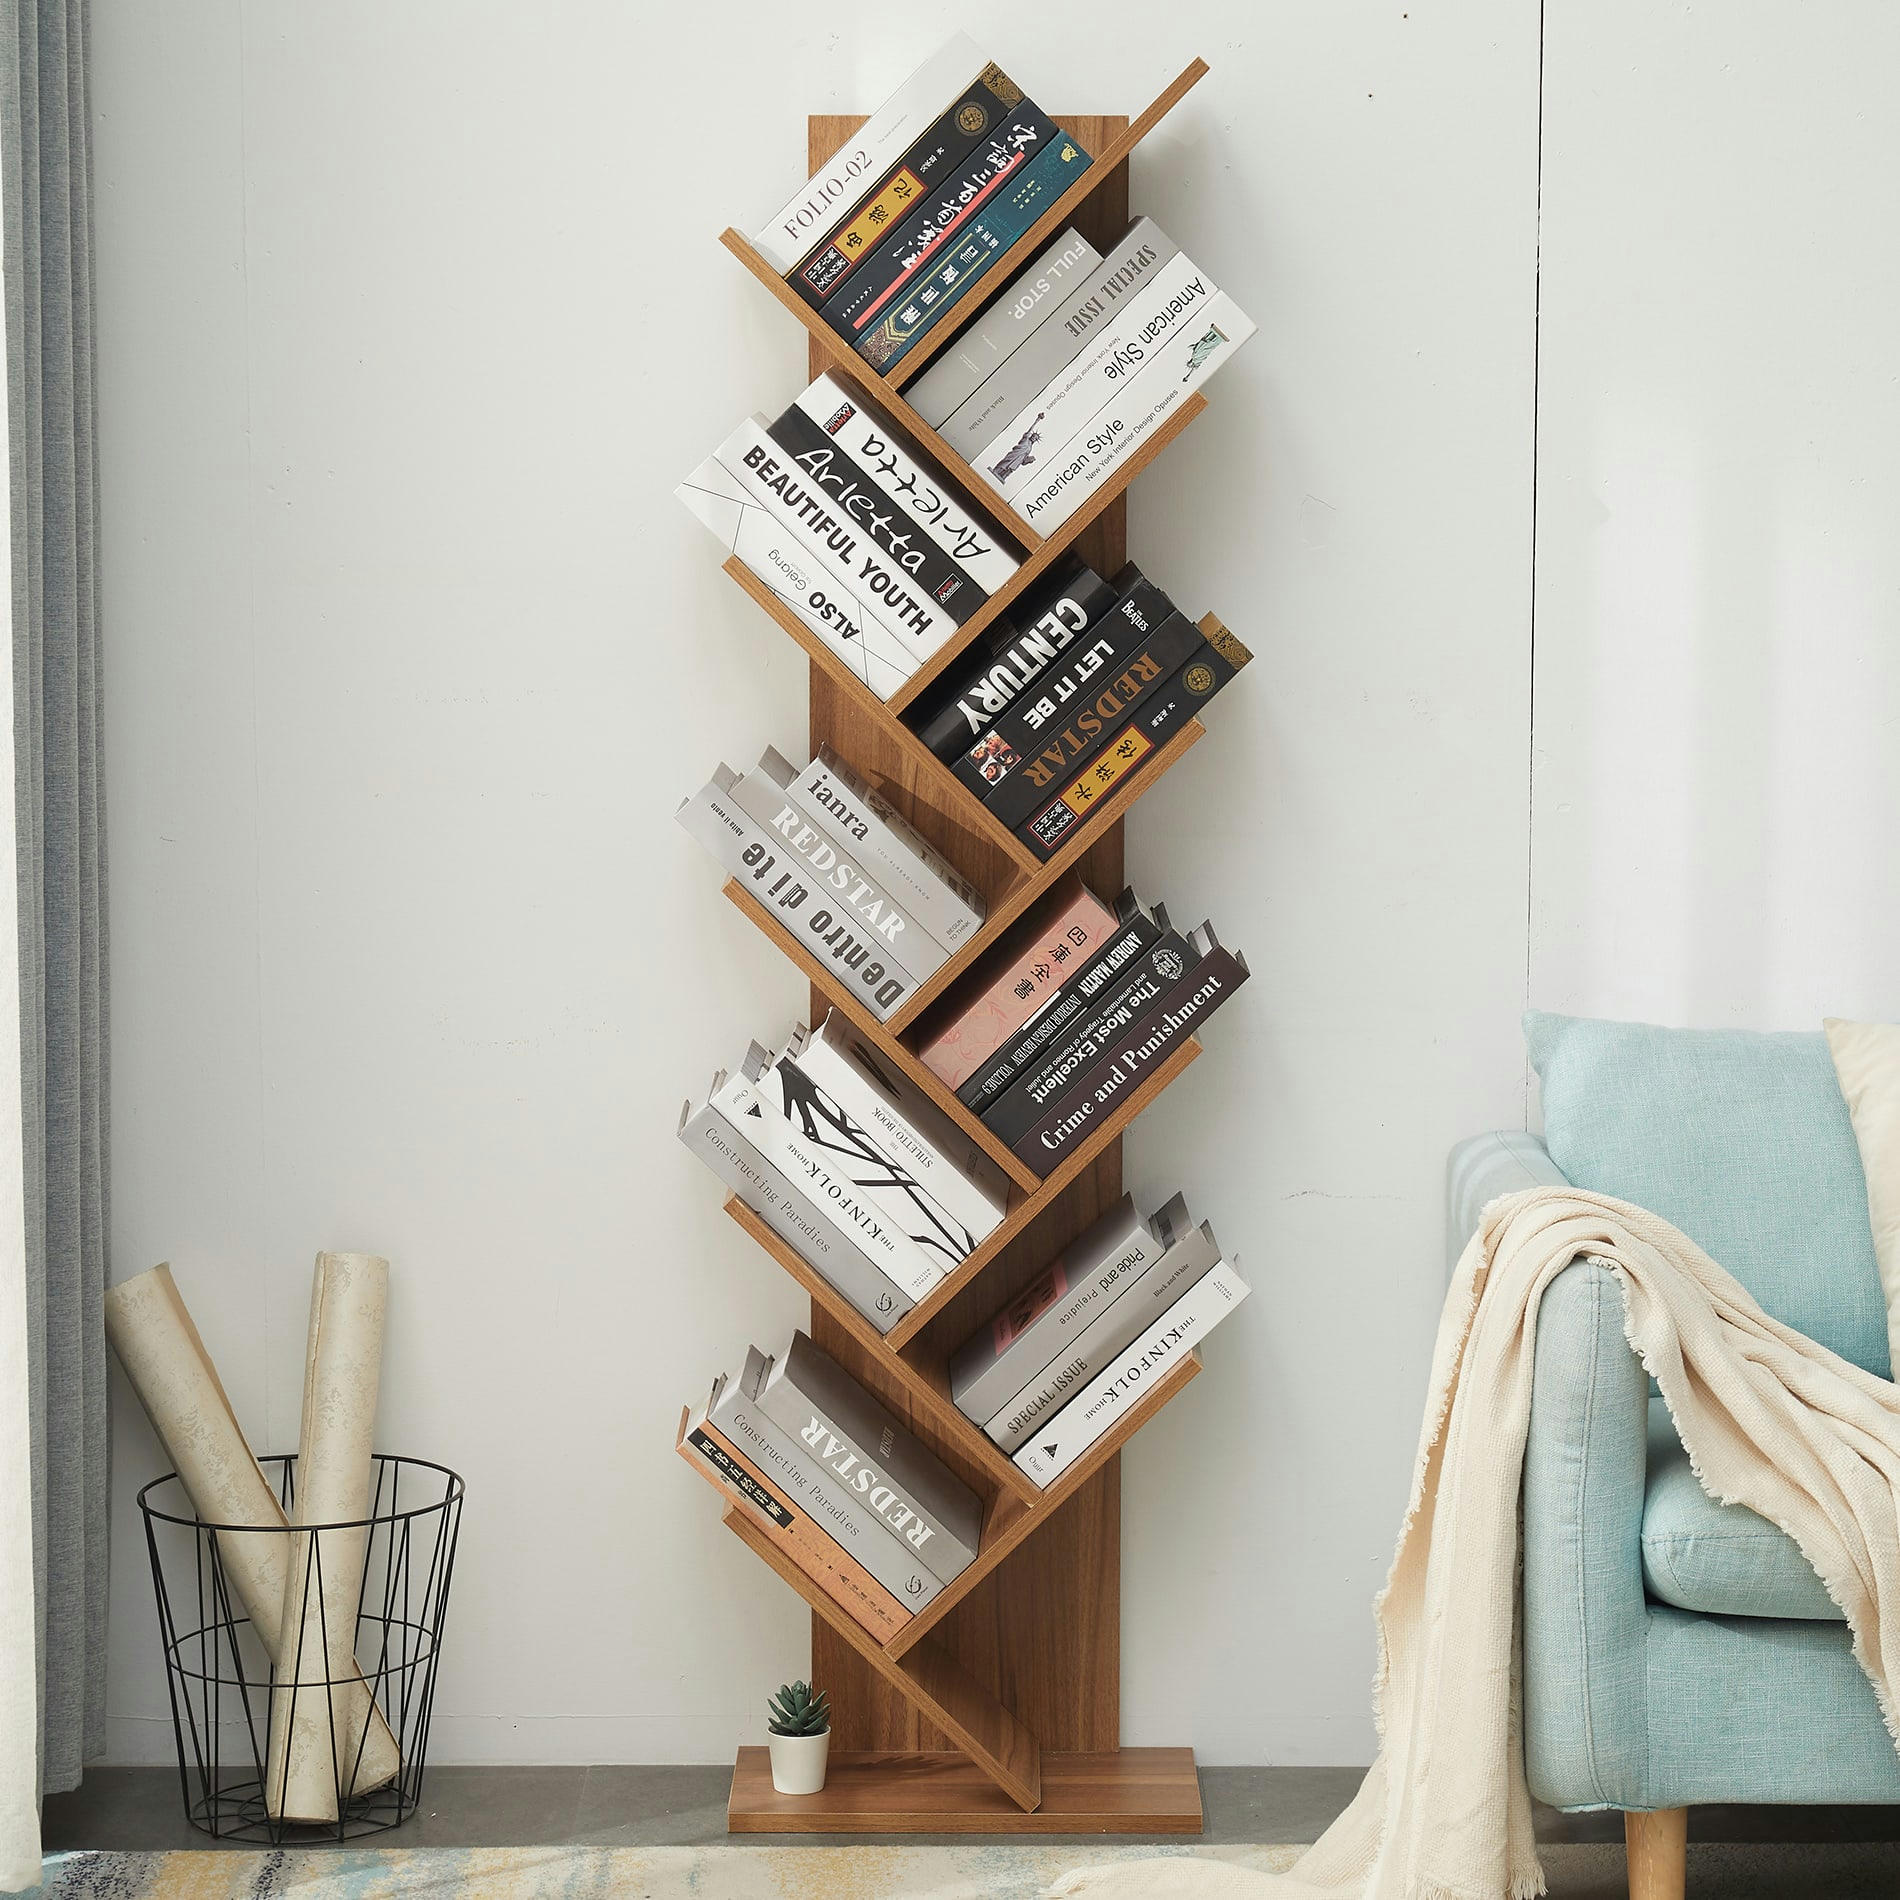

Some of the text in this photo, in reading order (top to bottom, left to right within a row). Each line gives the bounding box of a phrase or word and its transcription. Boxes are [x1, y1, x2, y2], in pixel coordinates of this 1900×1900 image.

[783, 149, 873, 240] FOLIO-02
[837, 177, 914, 250] 西游记
[1044, 240, 1087, 280] FULL
[1064, 244, 1157, 338] SPECIAL ISSUE
[1044, 334, 1122, 412] New York Interior Design Opuses
[1102, 276, 1206, 382] American Style
[980, 406, 992, 420] and
[1084, 388, 1180, 482] New York Interior Design Opuses
[791, 444, 928, 575] Arletta
[858, 432, 992, 562] Arletta
[1024, 416, 1126, 519] American Style
[742, 444, 934, 636] BEAUTIFUL YOUTH
[766, 548, 809, 591] Gelang
[807, 590, 861, 642] ALSO
[954, 596, 1089, 735] CENTURY
[1021, 638, 1115, 730] LET IT BE
[1021, 651, 1164, 788] REDSTAR
[807, 774, 870, 842] ianra
[1073, 739, 1138, 802] 水浒传
[768, 803, 906, 944] REDSTAR
[738, 840, 905, 1010] Dentro di te
[1012, 925, 1089, 1000] 四庫全書
[1104, 930, 1144, 972] ANDREW
[1076, 960, 1114, 998] MARTIN
[1008, 992, 1082, 1067] INTERIOR DESIGN REVIEW
[1024, 972, 1148, 1094] and Lamentable Tragedy of Romeo and Juliet
[1031, 978, 1160, 1104] The Most Excellent
[1040, 974, 1222, 1150] Crime and Punishment
[870, 1106, 898, 1132] BOOK
[980, 1061, 1014, 1096] VOLUME 9
[704, 1127, 831, 1253] Constructing Paradies
[894, 1130, 934, 1169] STILETTO
[784, 1142, 896, 1252] THE KINFOLK HOME
[1058, 1246, 1146, 1326] Pride and Prejudice
[1152, 1262, 1190, 1298] Black and White
[1007, 1356, 1089, 1435] SPECIAL ISSUE
[1082, 1314, 1196, 1422] THE KINFOLK HOME
[732, 1414, 808, 1488] Constructing
[808, 1485, 860, 1537] Paradies
[799, 1415, 936, 1551] REDSTAR
